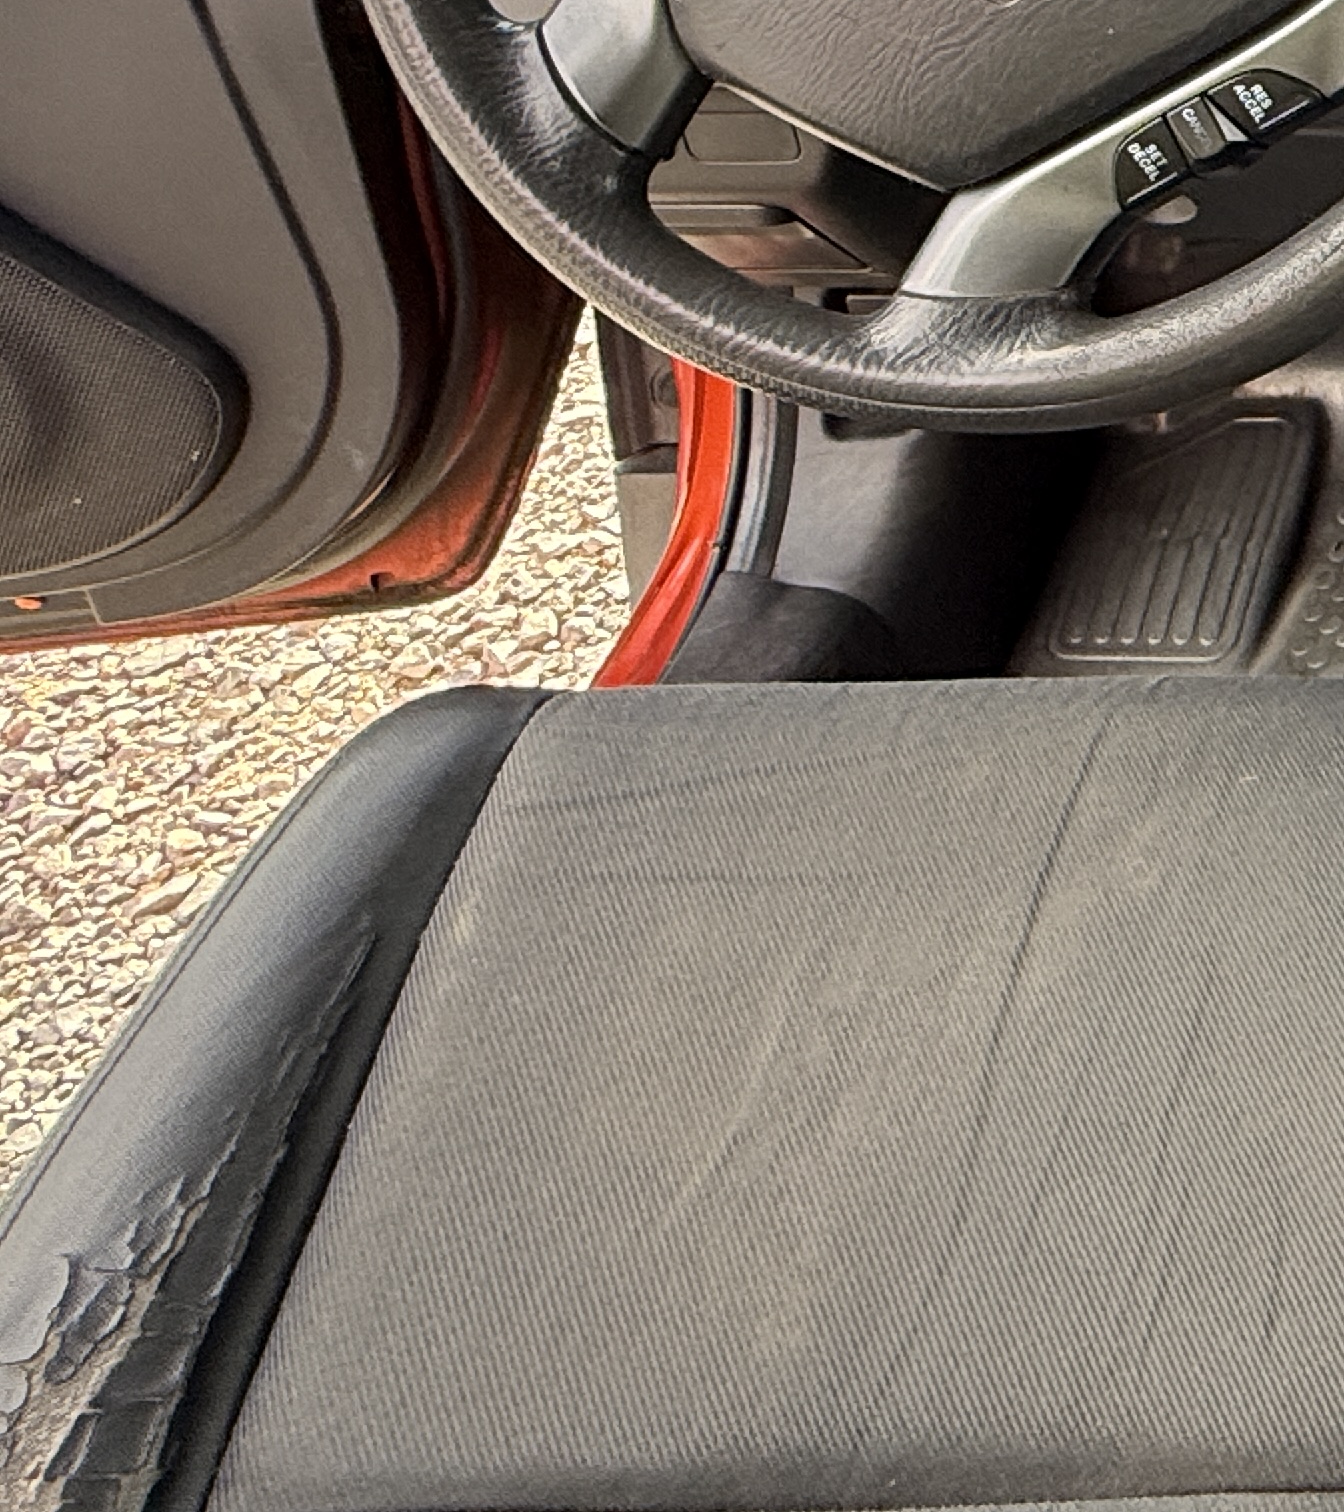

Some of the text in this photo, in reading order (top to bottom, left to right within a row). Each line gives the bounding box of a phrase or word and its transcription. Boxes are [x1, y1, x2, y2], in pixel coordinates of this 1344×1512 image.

[1232, 84, 1266, 124] ACCEL
[1250, 83, 1274, 110] RES
[1126, 142, 1160, 182] DECEL
[1144, 143, 1168, 167] SET
